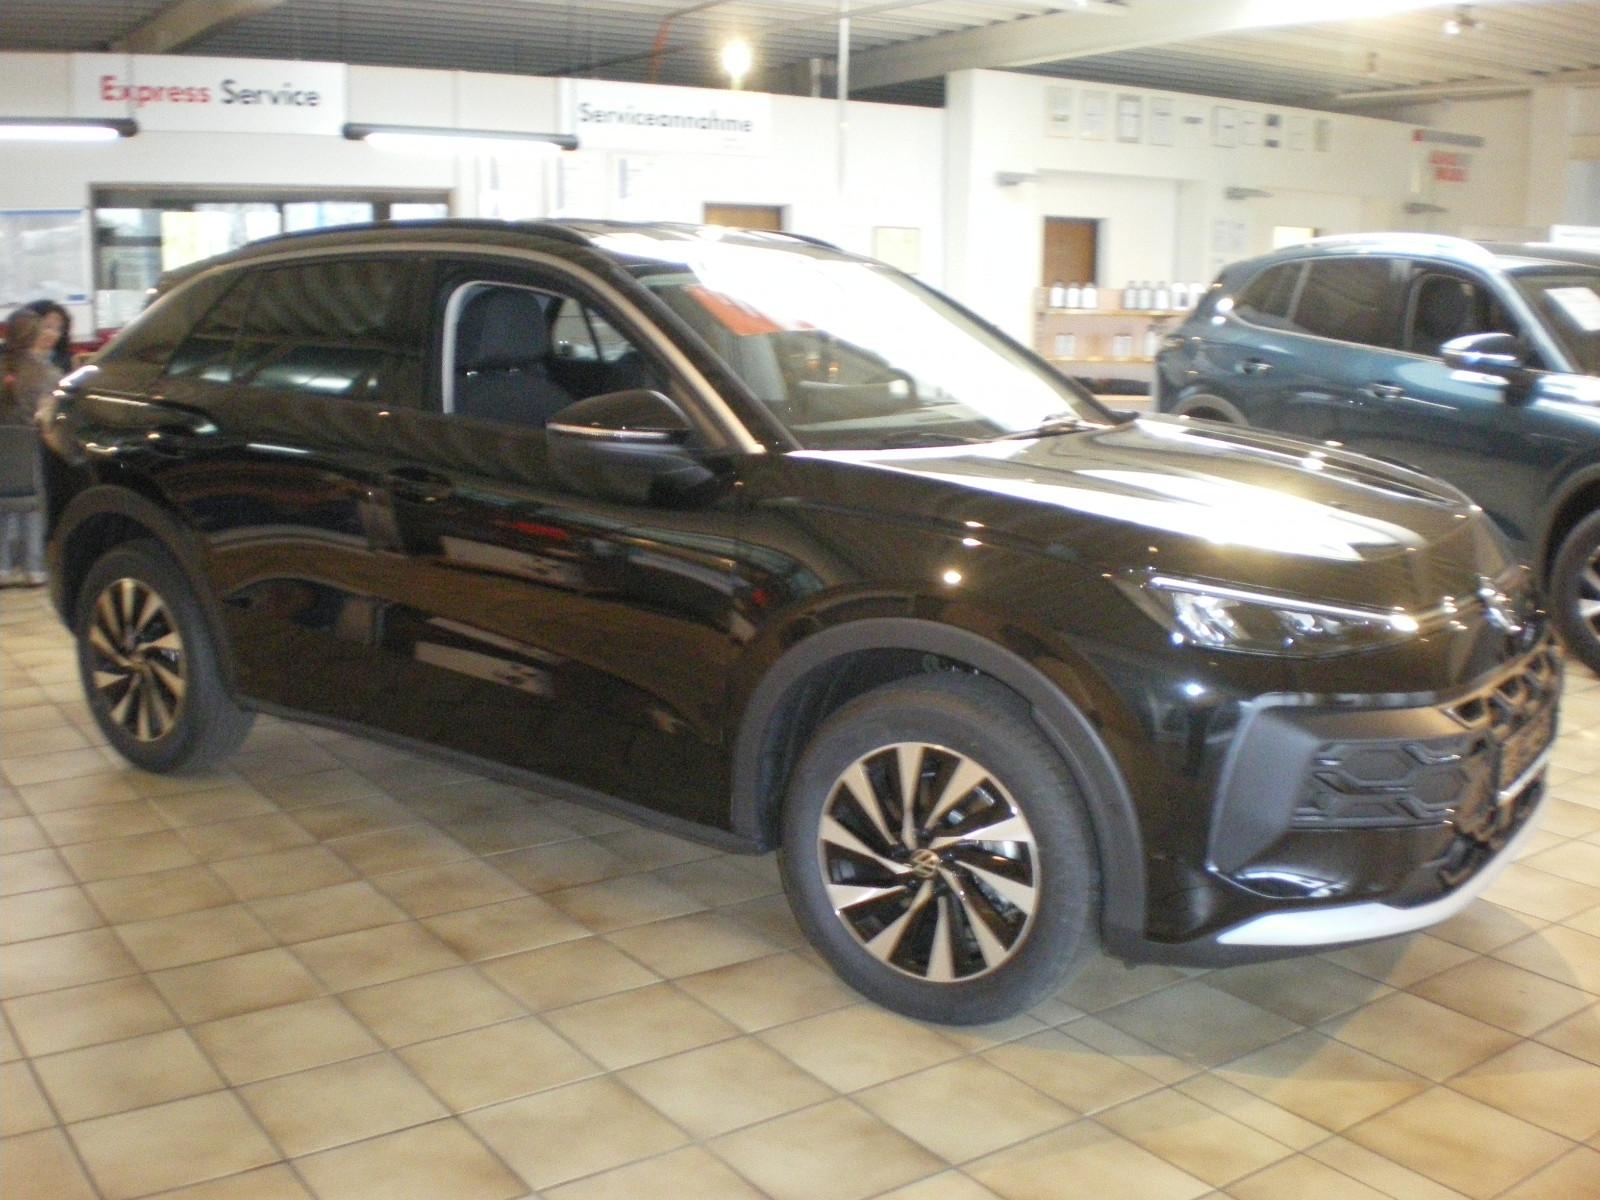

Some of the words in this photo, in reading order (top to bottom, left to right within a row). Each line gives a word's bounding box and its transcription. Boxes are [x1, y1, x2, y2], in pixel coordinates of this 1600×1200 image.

[101, 75, 211, 107] Express
[220, 79, 320, 107] Service
[578, 101, 753, 132] Serviceannahme
